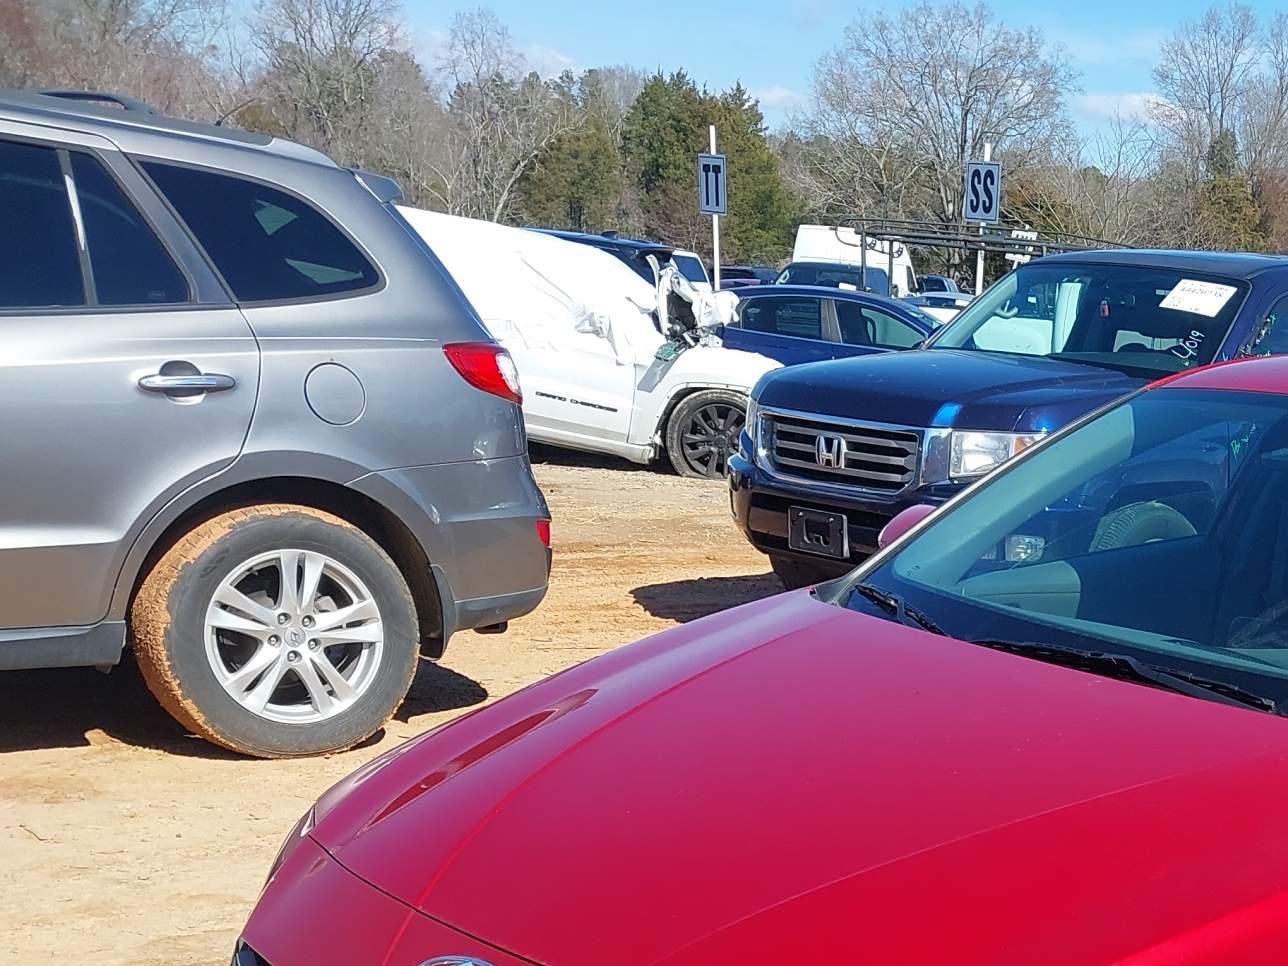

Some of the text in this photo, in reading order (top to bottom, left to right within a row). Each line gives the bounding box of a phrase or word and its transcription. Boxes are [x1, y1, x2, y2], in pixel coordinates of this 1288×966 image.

[702, 164, 721, 207] TT
[969, 169, 995, 214] SS
[1171, 330, 1205, 359] 4019
